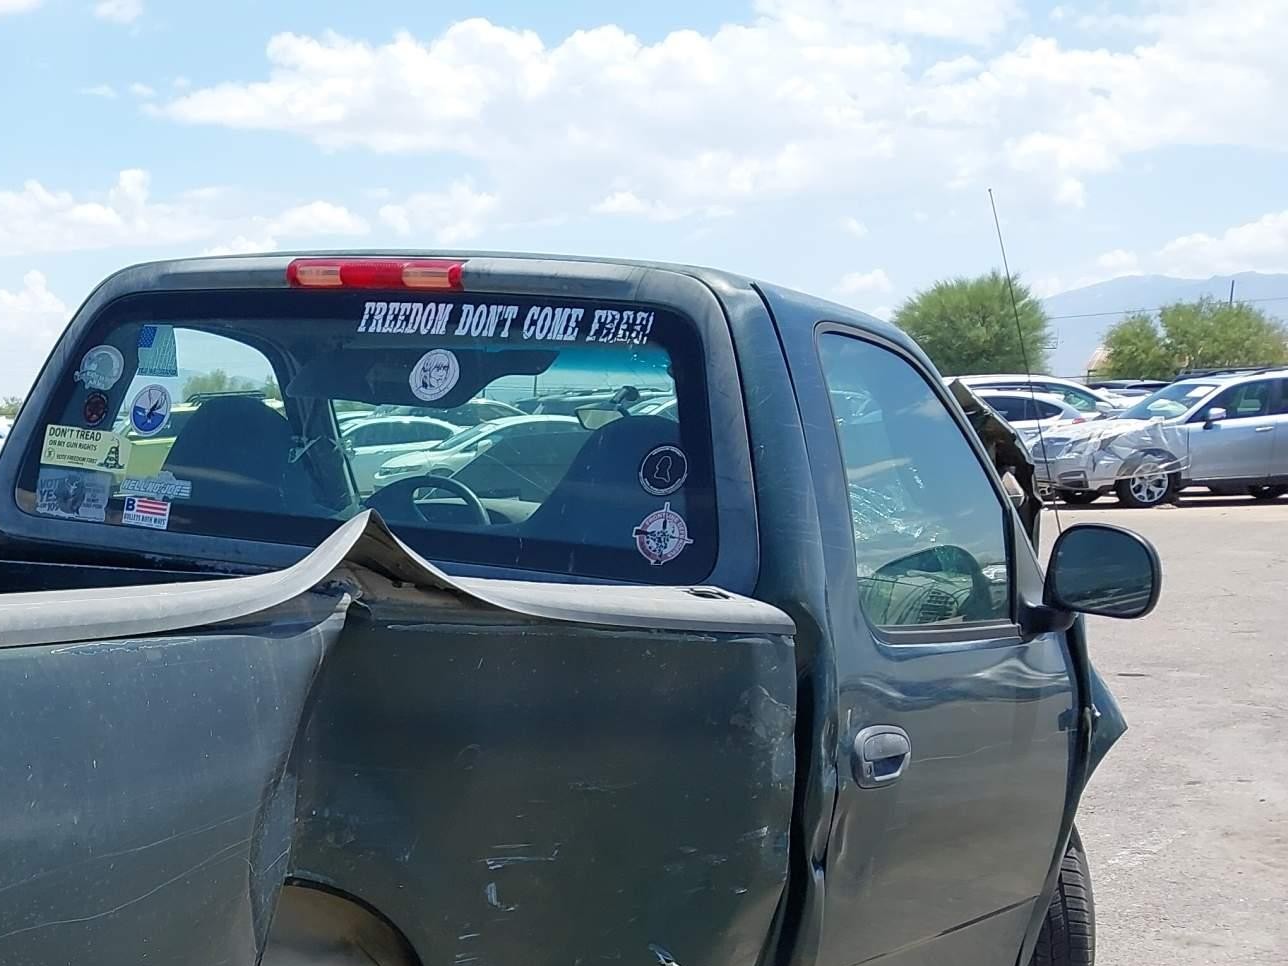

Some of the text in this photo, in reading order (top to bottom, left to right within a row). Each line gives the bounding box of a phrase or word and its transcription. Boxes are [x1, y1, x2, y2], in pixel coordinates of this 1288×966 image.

[357, 302, 454, 334] FREEDOM
[455, 304, 519, 338] DON'T
[523, 306, 584, 341] COME
[48, 427, 102, 442] DON'T TREAD
[66, 441, 78, 449] GUN
[78, 443, 98, 452] RIGHTS
[122, 479, 147, 491] HELL
